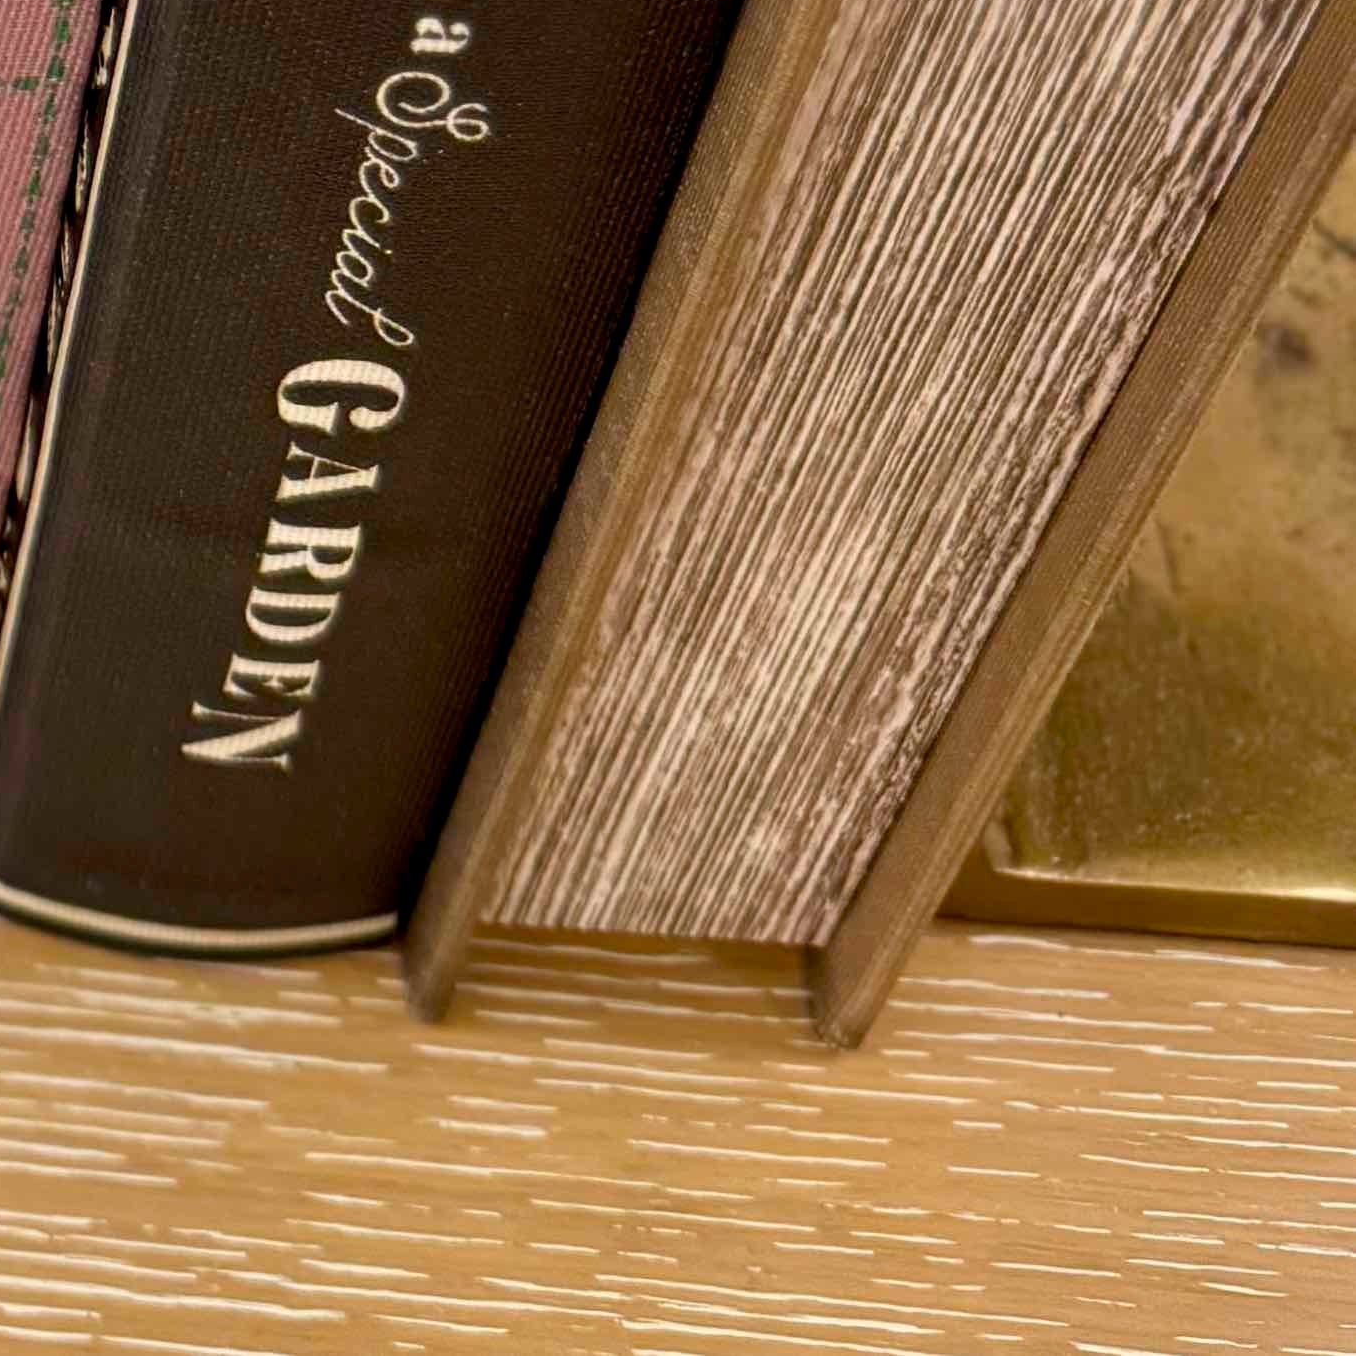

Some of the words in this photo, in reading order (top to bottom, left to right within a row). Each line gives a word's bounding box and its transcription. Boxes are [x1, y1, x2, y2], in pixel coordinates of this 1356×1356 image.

[410, 16, 471, 55] a
[324, 71, 489, 346] Special
[182, 359, 405, 772] GARDEN
